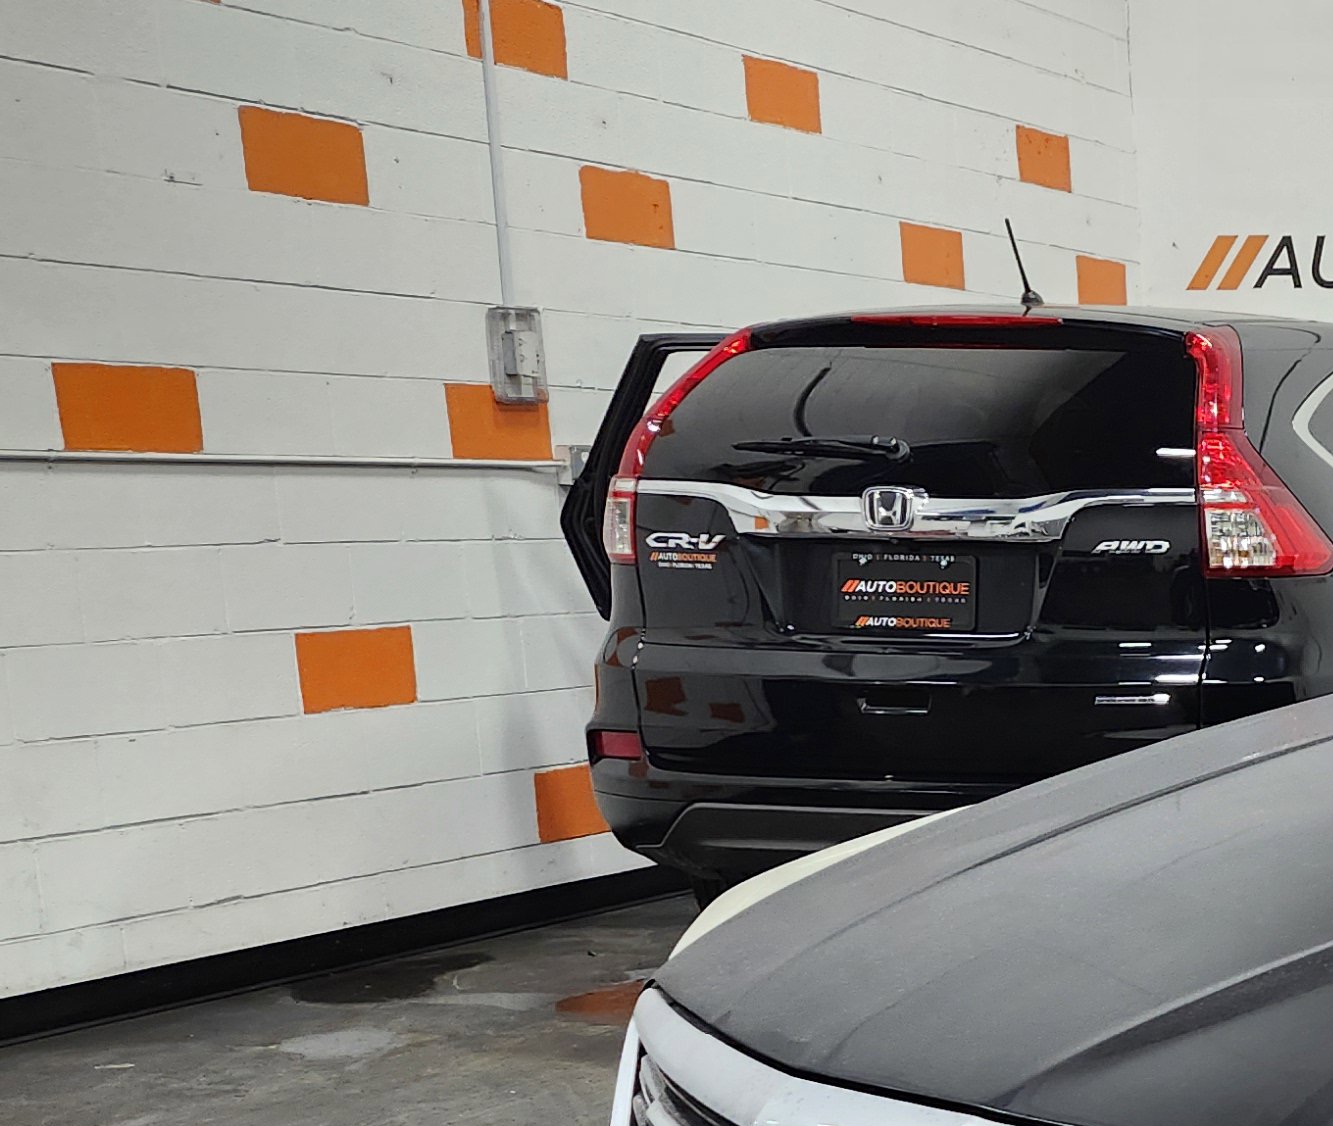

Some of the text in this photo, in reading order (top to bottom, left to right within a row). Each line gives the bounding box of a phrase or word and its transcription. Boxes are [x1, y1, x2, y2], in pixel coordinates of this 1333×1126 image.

[645, 532, 727, 550] CR-V
[1090, 540, 1171, 555] AWD
[855, 581, 971, 595] AUTOBOUTIQUE
